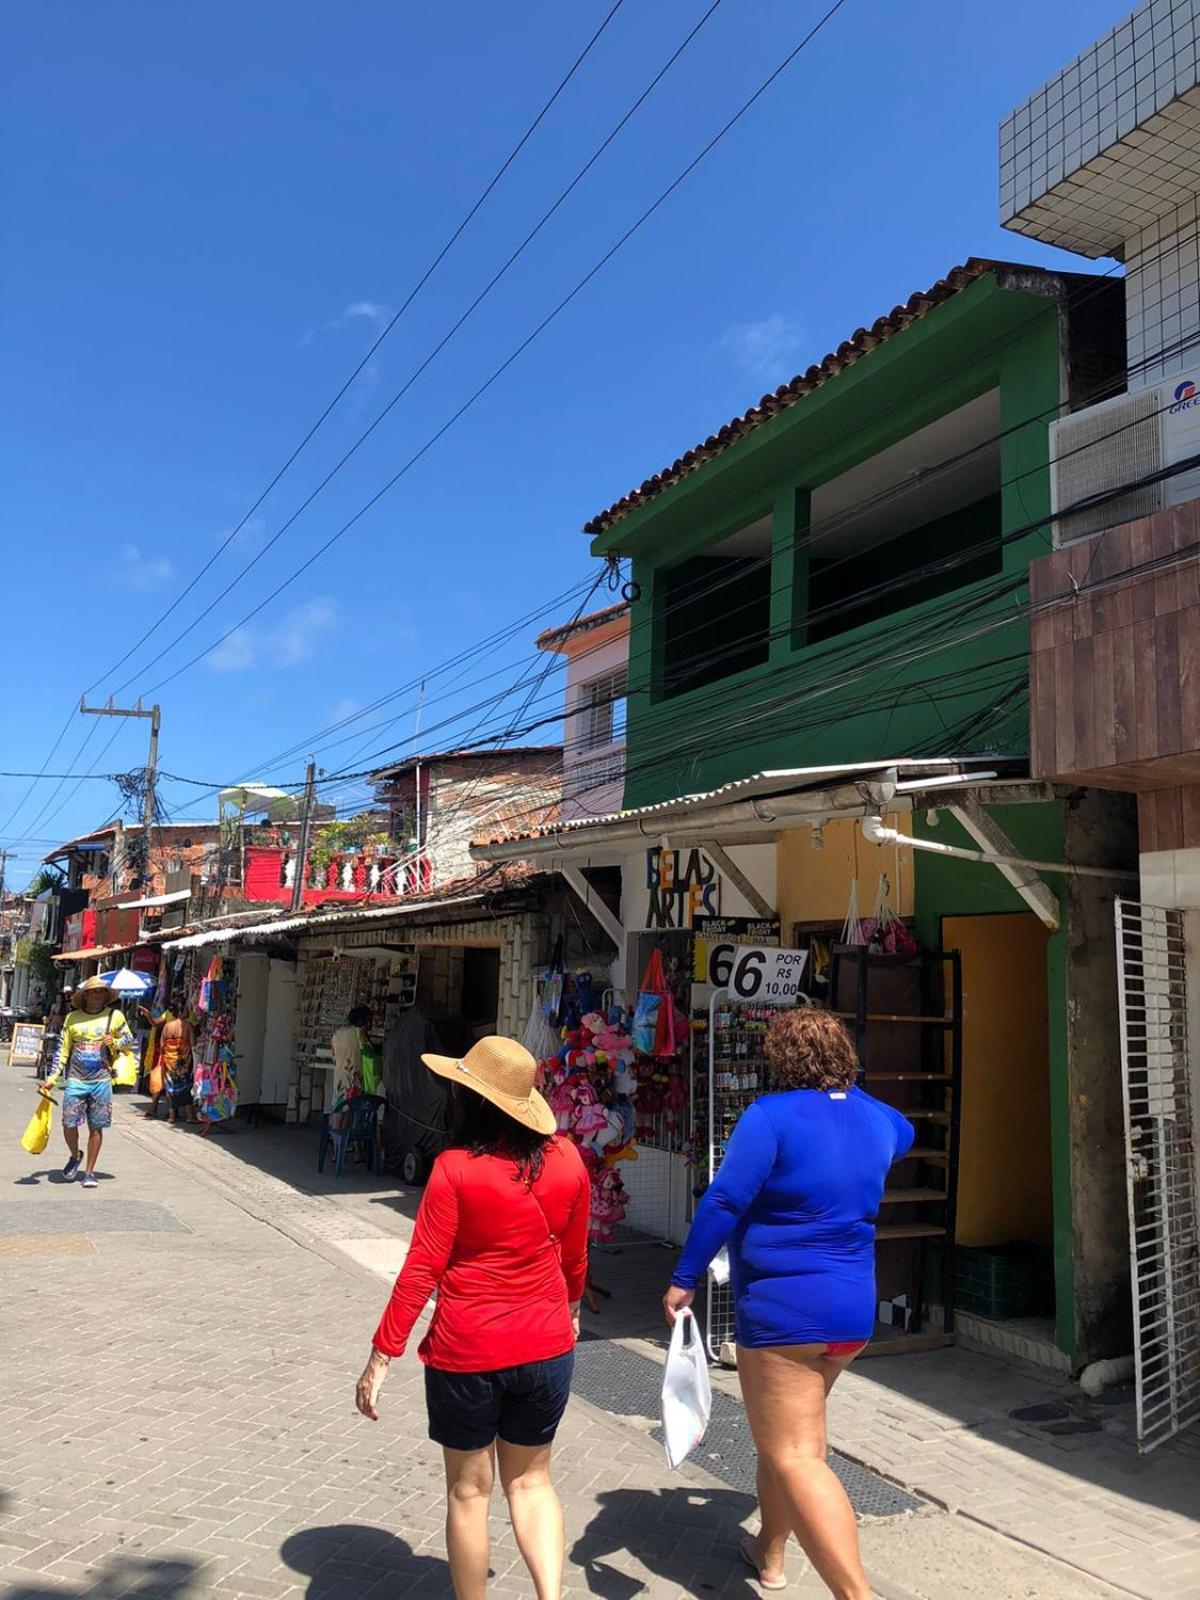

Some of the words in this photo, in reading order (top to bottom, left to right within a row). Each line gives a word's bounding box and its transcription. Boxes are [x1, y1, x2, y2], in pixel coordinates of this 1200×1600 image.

[647, 848, 715, 892] BELAS
[646, 883, 717, 929] ARTES
[733, 950, 767, 998] 6
[775, 953, 802, 966] POR
